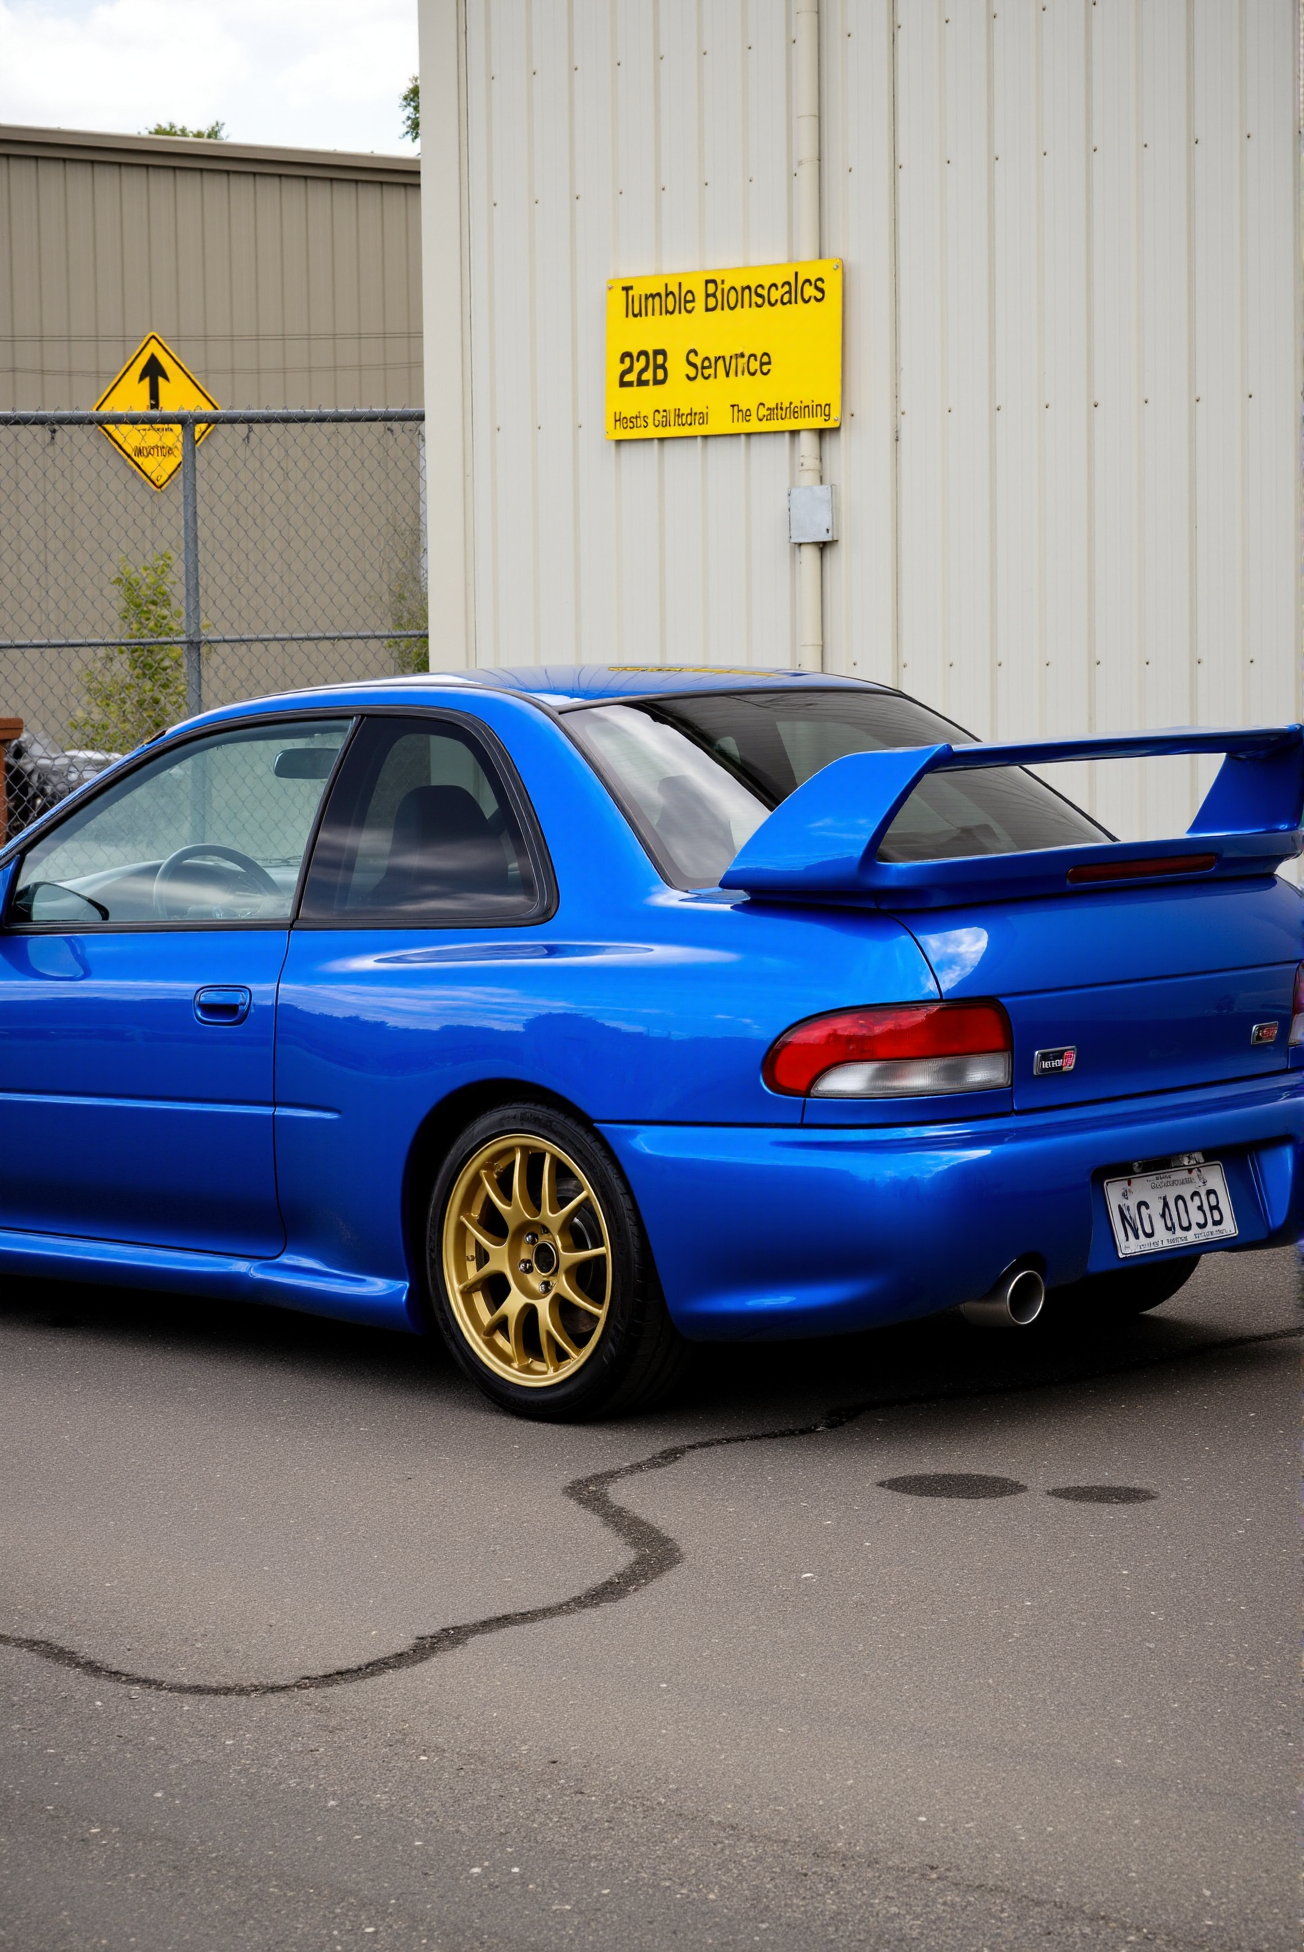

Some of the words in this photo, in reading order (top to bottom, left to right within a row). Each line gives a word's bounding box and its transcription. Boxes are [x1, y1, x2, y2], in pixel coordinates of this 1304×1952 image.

[621, 282, 695, 318] Tumble
[618, 348, 668, 388] 22B
[730, 403, 751, 423] The
